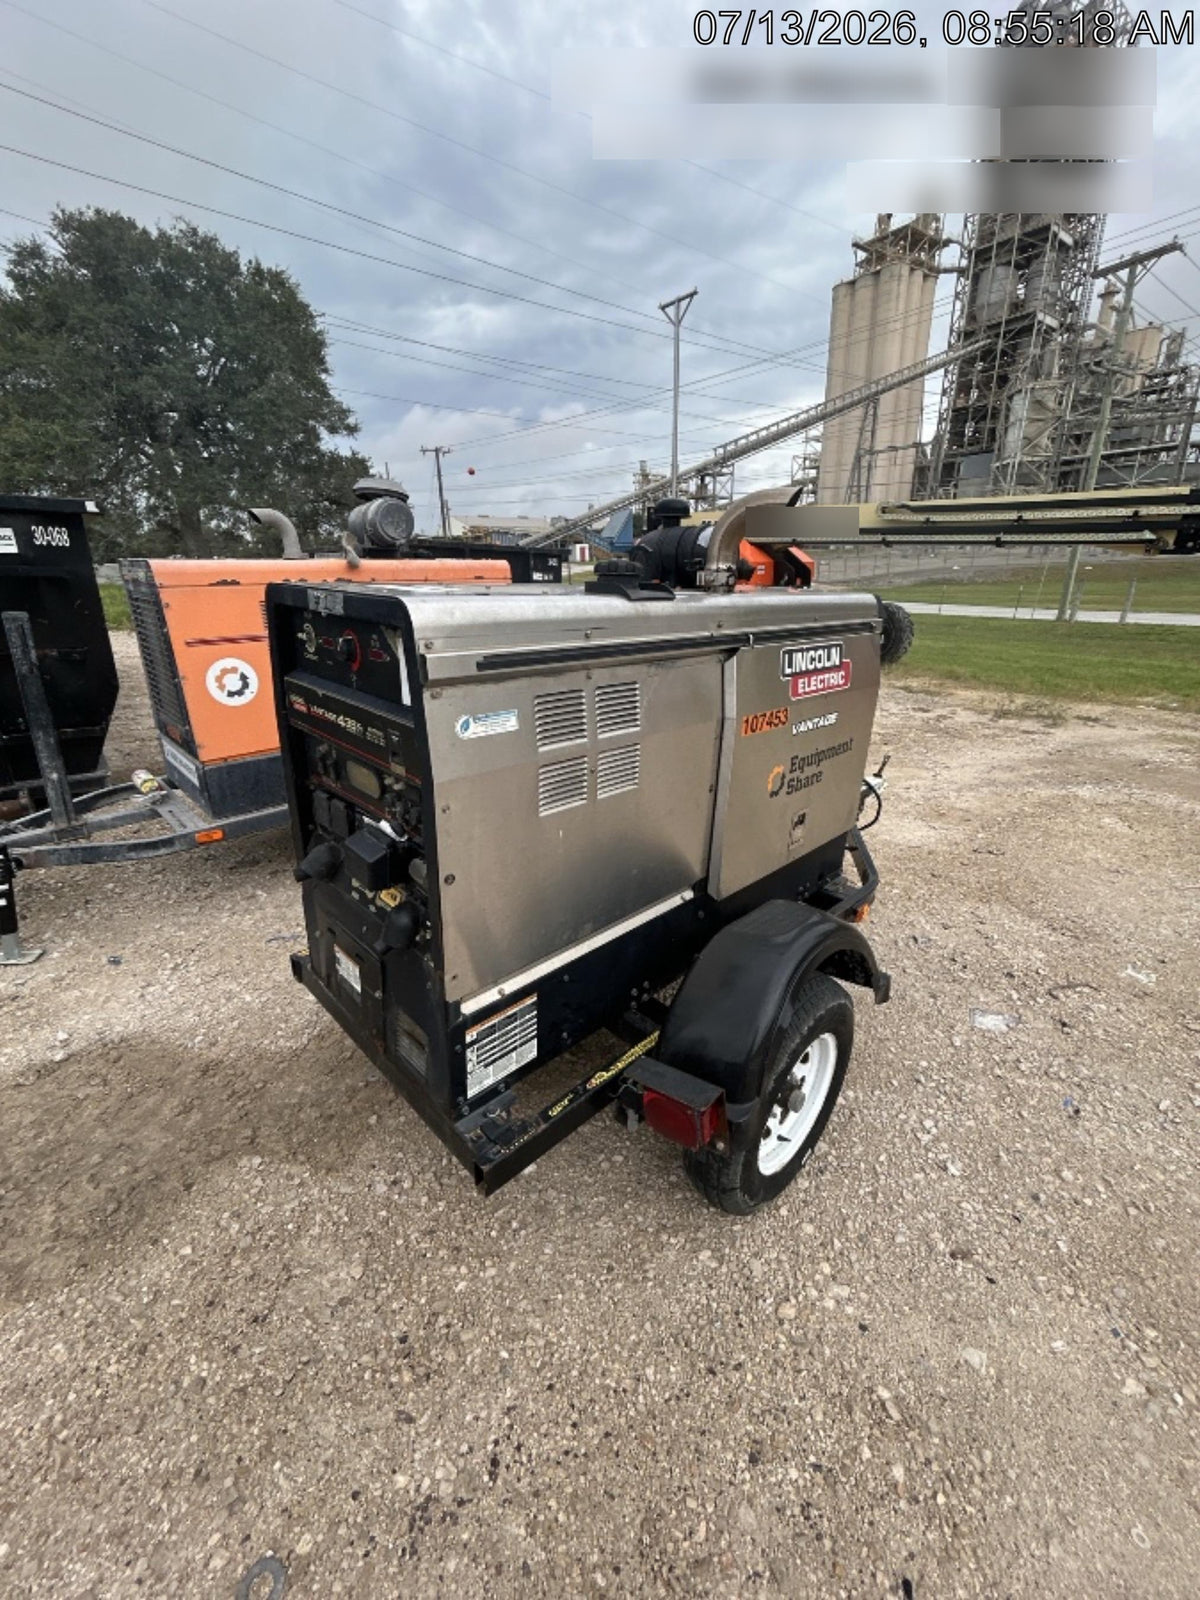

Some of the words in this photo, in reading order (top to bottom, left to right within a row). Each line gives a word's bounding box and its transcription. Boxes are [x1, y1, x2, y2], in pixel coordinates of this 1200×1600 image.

[31, 525, 70, 547] 30-068
[784, 646, 840, 675] LINCOLN
[797, 670, 846, 694] ELECTRIC
[742, 707, 789, 735] 107453
[789, 737, 854, 774] Equipment
[785, 770, 824, 796] Share
